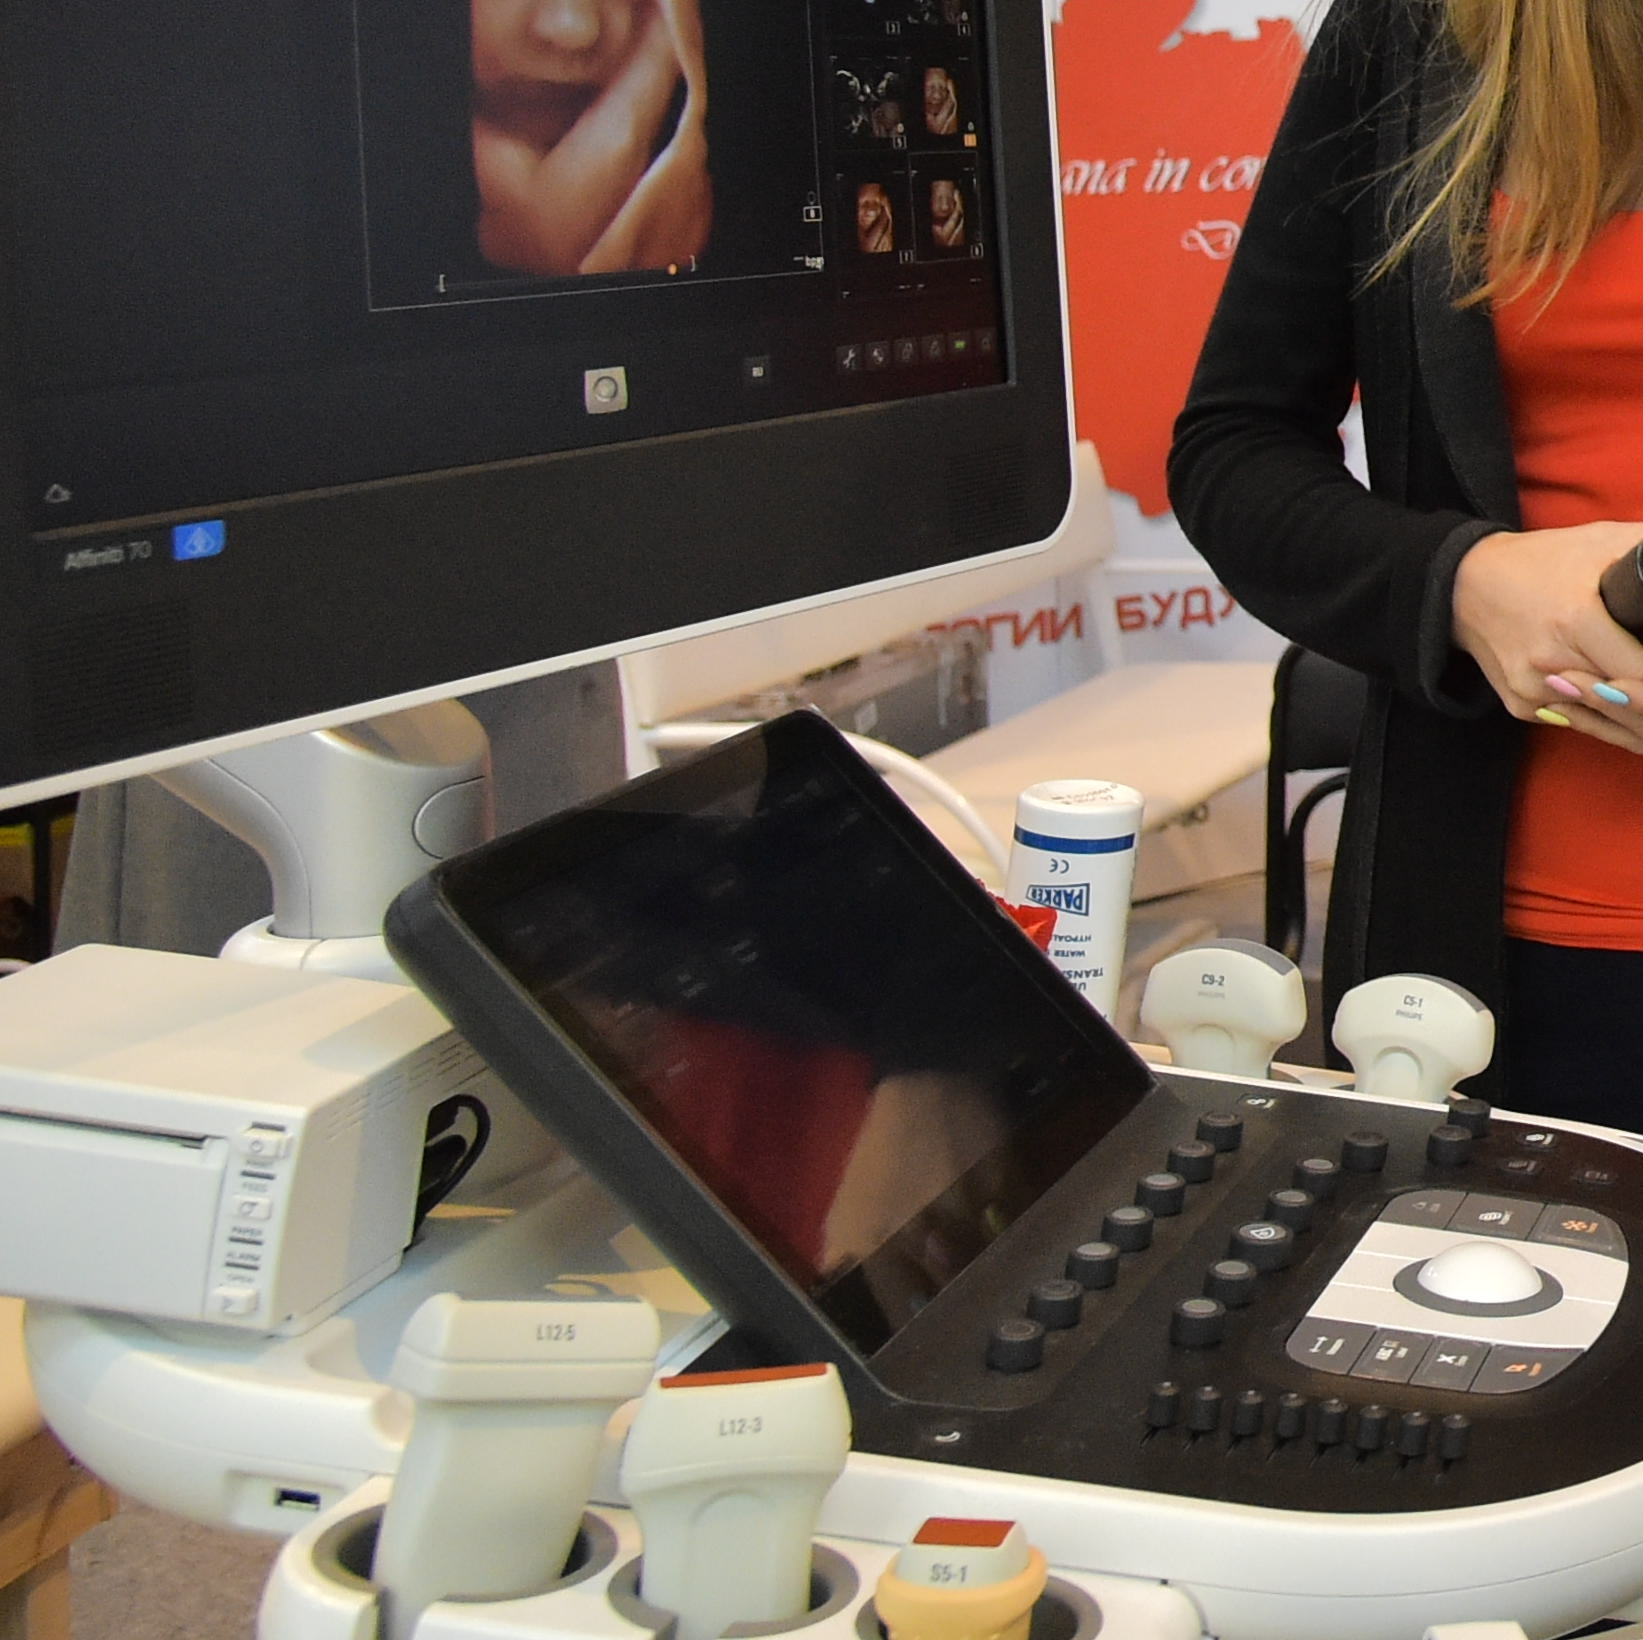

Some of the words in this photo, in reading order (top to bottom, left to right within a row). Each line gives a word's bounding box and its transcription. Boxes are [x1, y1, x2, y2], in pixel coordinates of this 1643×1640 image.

[1144, 148, 1191, 192] in
[1031, 886, 1084, 911] PARKER
[1053, 949, 1086, 958] WATER
[1063, 968, 1104, 979] TRANS
[1202, 973, 1225, 986] C9-2
[1403, 994, 1423, 1008] C5-1
[536, 1325, 576, 1342] L12-5
[719, 1417, 763, 1437] L12-3
[931, 1563, 968, 1584] S5-1
